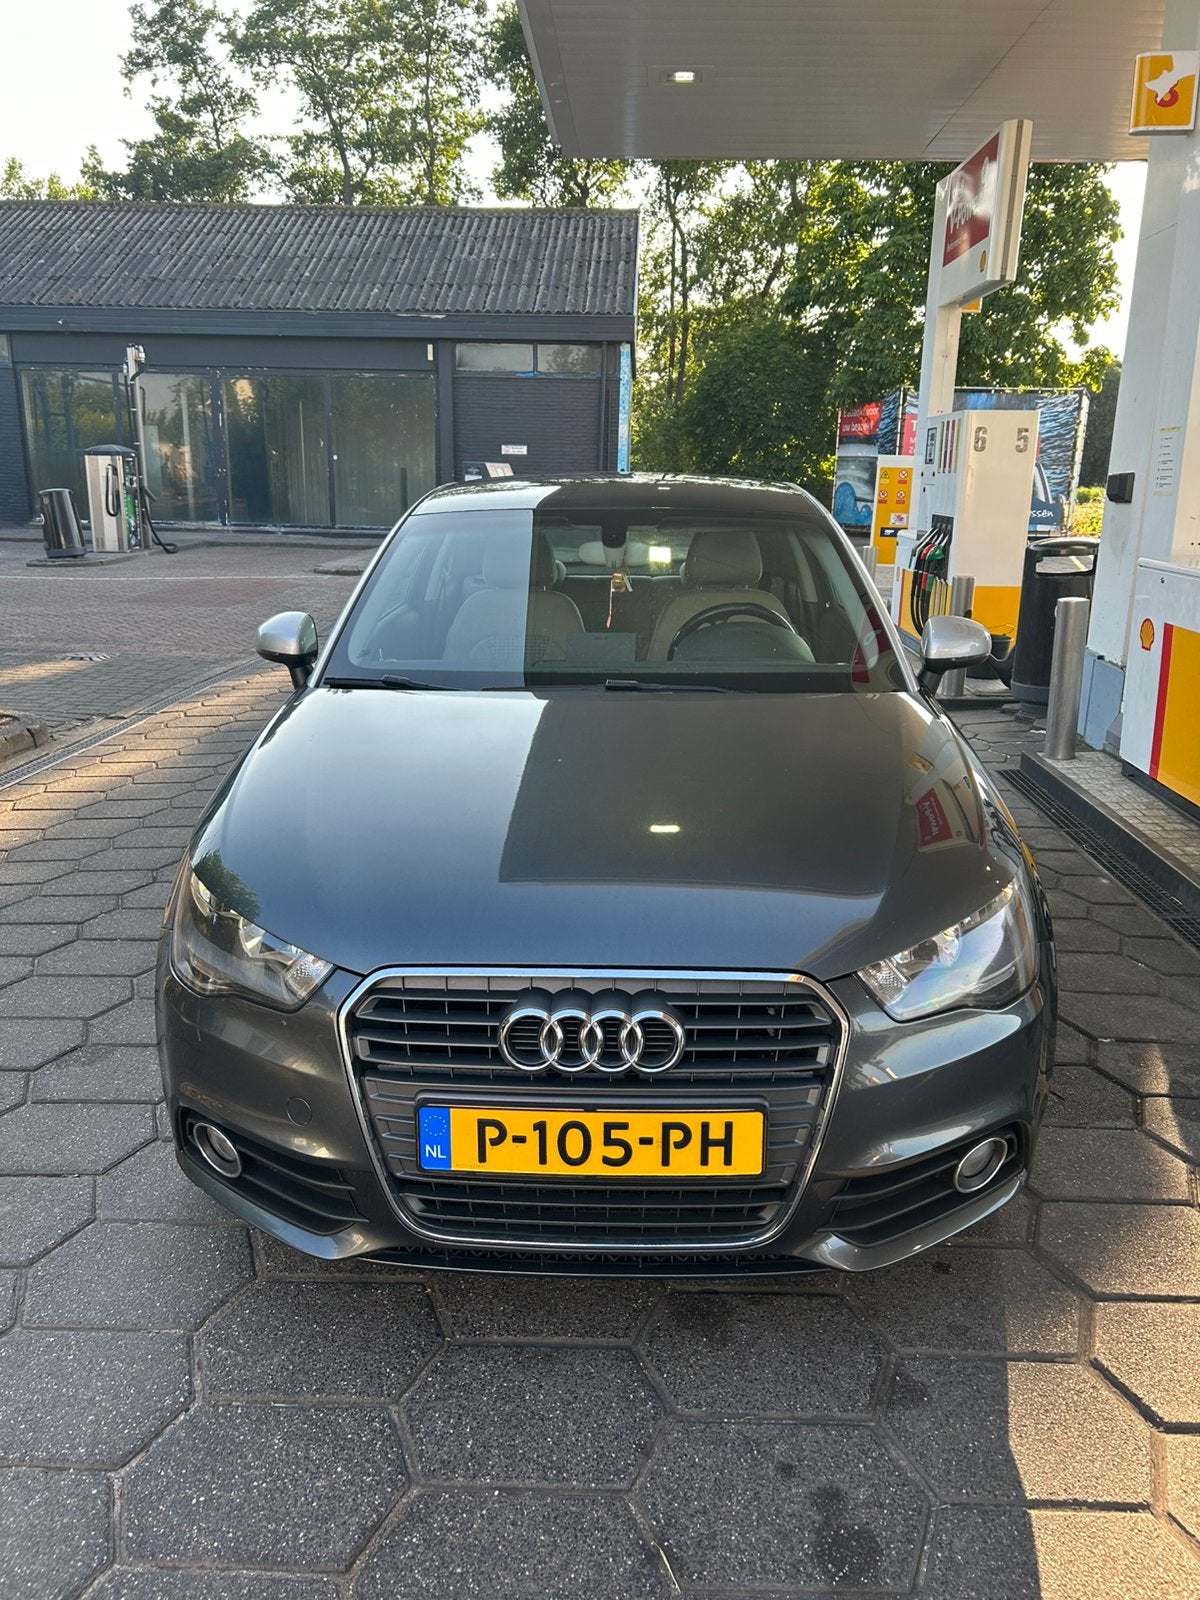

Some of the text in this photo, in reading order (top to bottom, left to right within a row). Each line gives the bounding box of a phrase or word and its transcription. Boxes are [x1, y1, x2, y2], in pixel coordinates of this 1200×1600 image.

[974, 426, 988, 452] 6
[1015, 427, 1030, 453] 5
[1031, 509, 1053, 518] ssen
[425, 1144, 447, 1159] NL
[476, 1118, 734, 1168] P-105-PH
